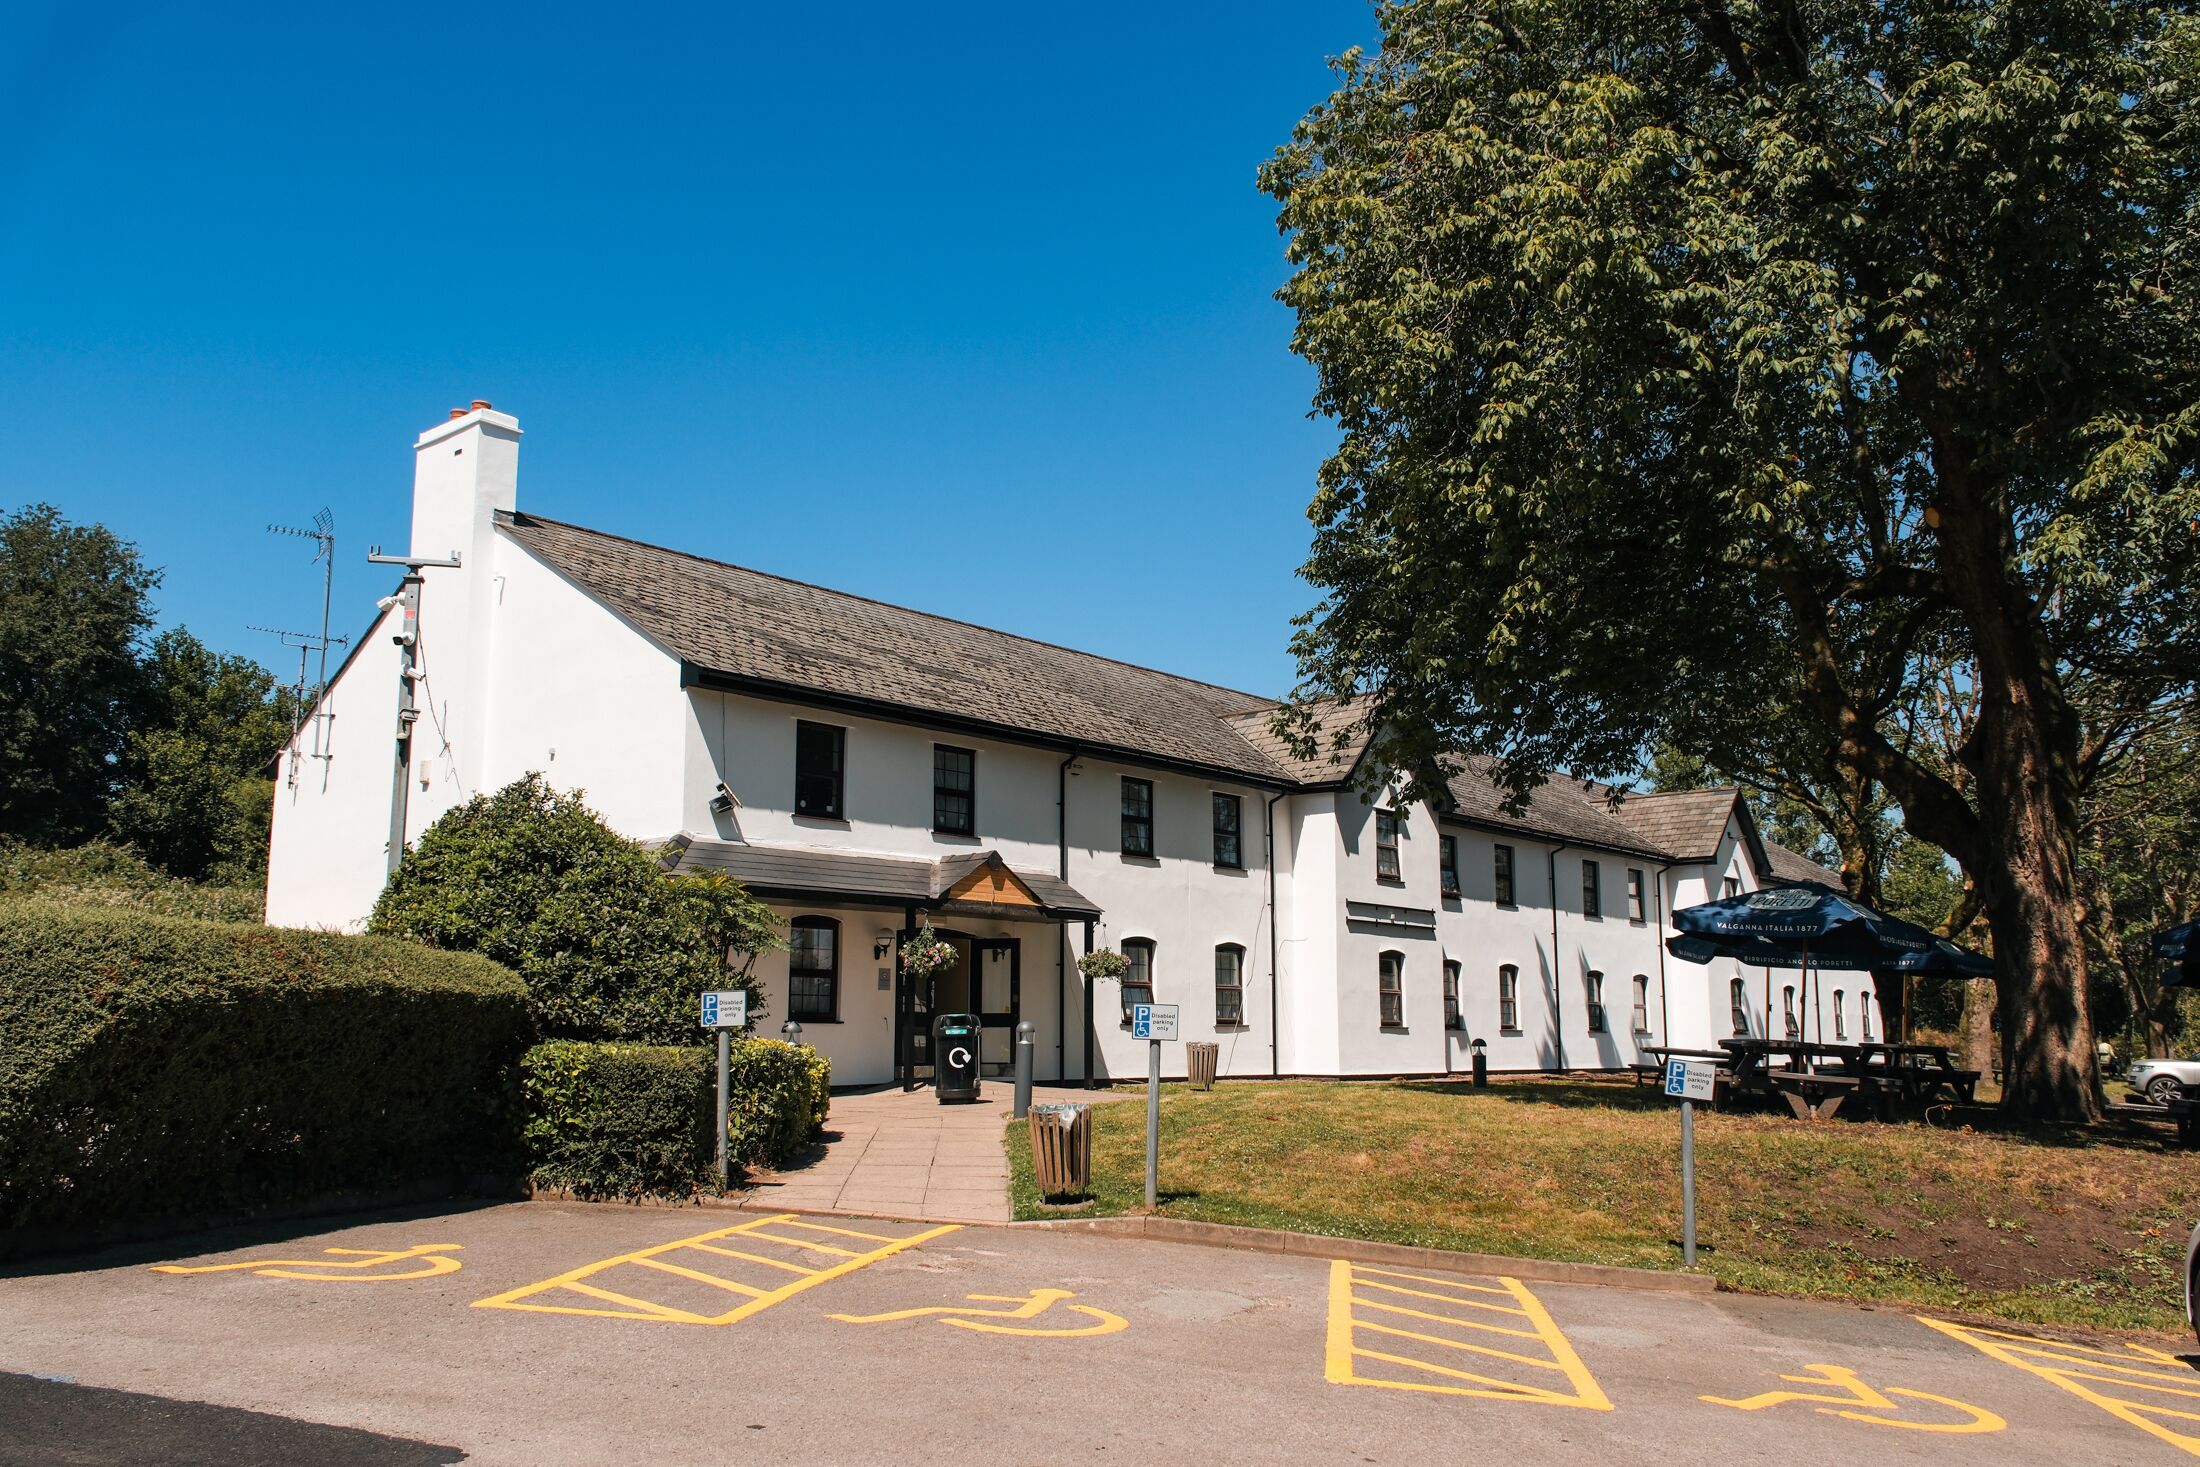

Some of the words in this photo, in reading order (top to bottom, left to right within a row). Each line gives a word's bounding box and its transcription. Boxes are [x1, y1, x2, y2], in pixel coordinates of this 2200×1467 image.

[1753, 896, 1812, 906] PORETTI
[1716, 922, 1763, 931] VALGANNA
[1765, 924, 1793, 932] ITALIA
[1744, 955, 1785, 964] BIRRIFICIO
[706, 995, 717, 1009] P
[1138, 1007, 1149, 1021] P
[1673, 1062, 1684, 1076] P
[1686, 1070, 1712, 1078] Disabled
[1687, 1077, 1710, 1085] parking
